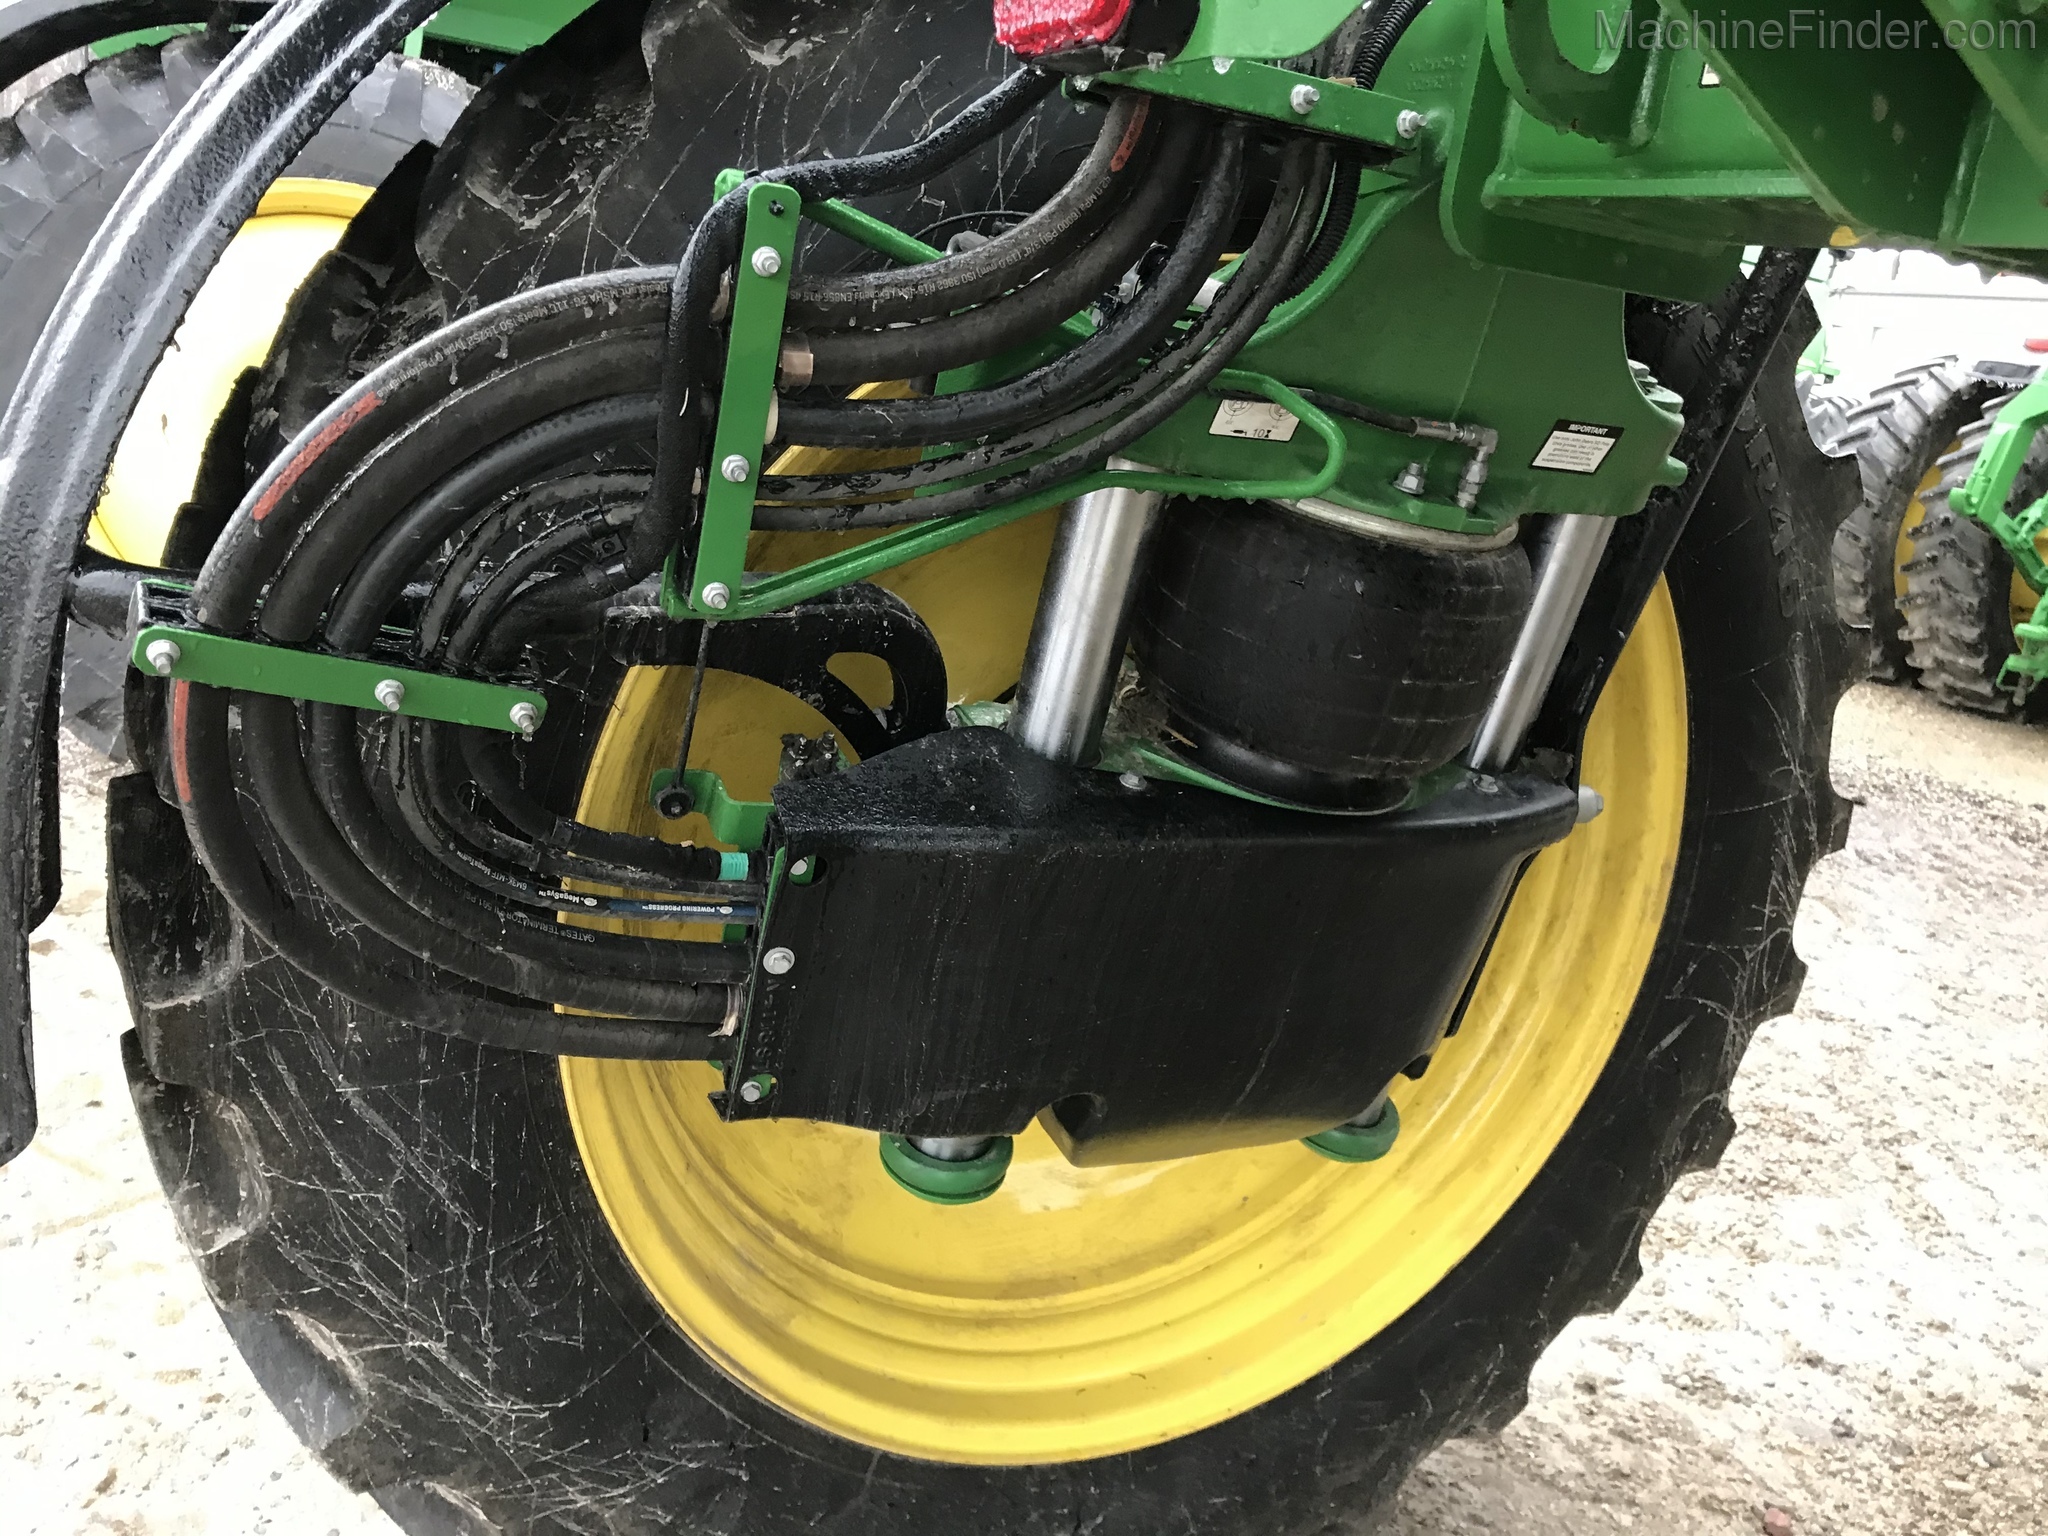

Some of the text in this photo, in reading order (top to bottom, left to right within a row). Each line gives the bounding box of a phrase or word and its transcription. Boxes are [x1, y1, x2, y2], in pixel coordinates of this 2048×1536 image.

[1079, 193, 1098, 211] MPa
[1057, 208, 1082, 232] (6000
[1040, 229, 1058, 246] PSI)
[937, 279, 960, 291] 3862
[961, 271, 977, 284] ISO
[589, 288, 620, 303] MSHA
[497, 316, 516, 332] ISO
[443, 337, 468, 356] Type
[376, 359, 437, 398] Performance
[1568, 424, 1609, 436] IMPORTANT
[682, 904, 715, 913] POWERING
